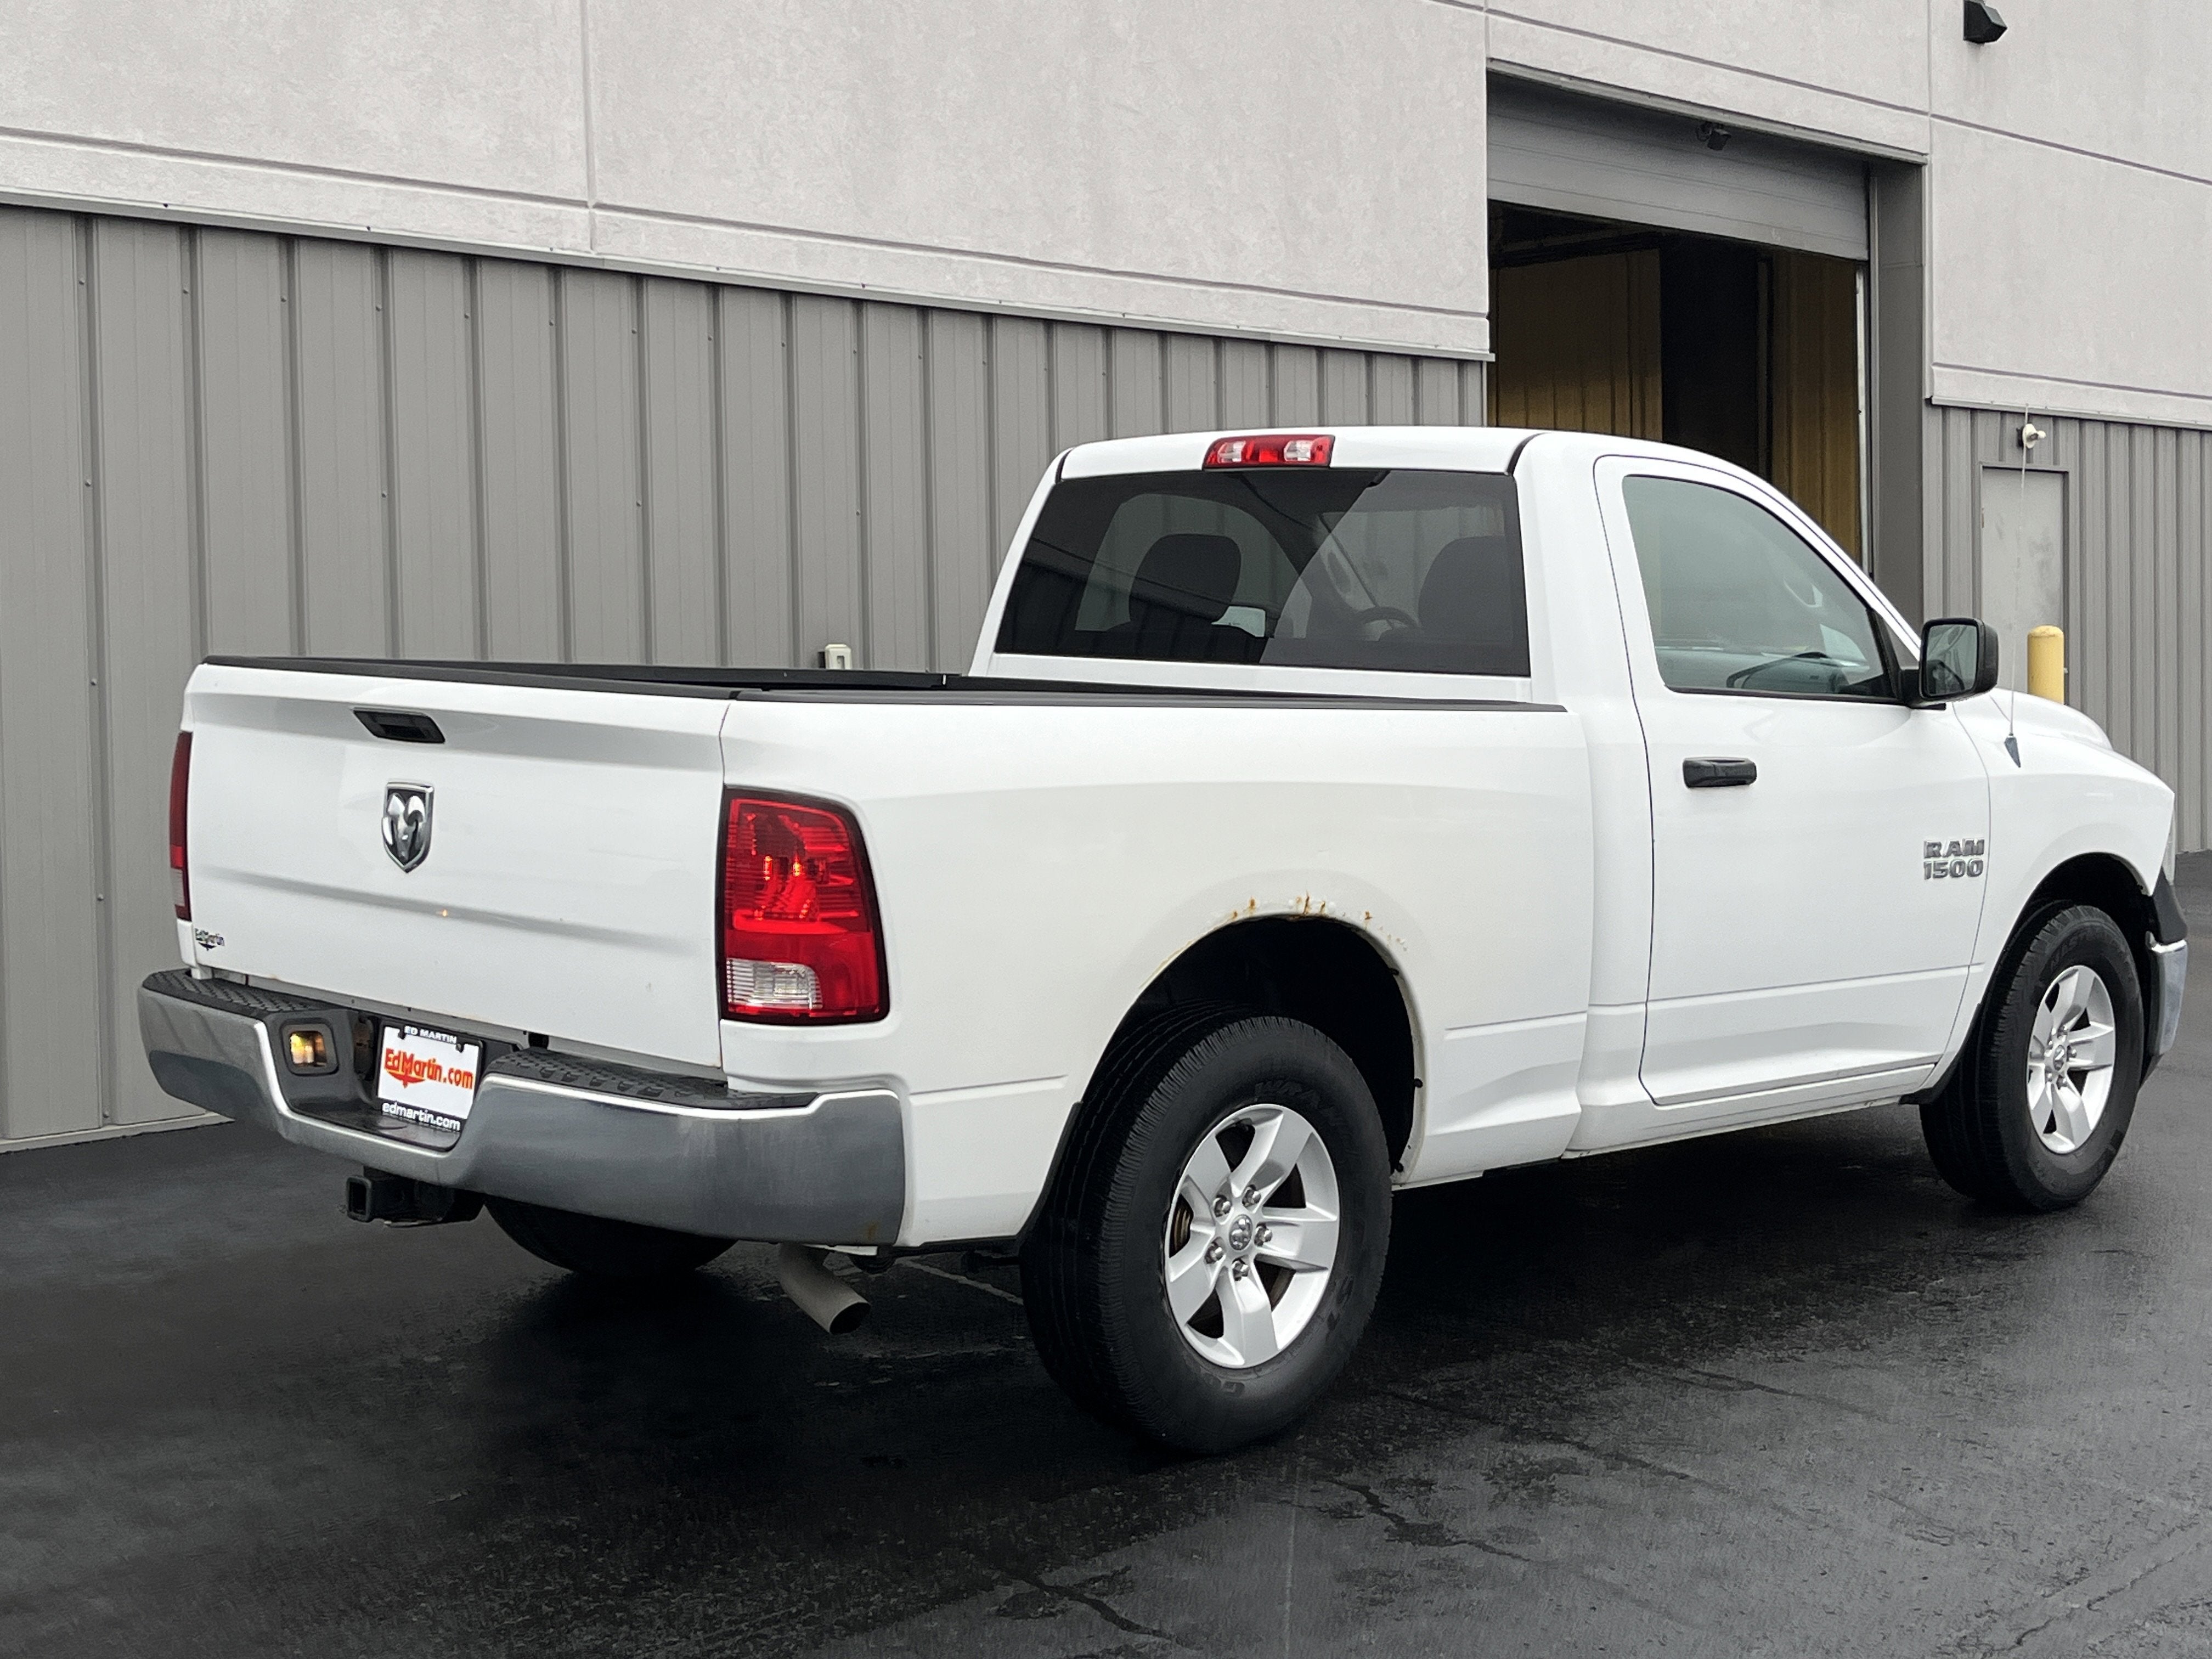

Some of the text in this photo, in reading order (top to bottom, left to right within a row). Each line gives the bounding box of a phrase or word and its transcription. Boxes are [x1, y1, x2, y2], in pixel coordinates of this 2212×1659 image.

[1923, 838, 1984, 859] RAM
[1923, 859, 1983, 880] 1500
[404, 1025, 456, 1043] ED MARTIN
[382, 1101, 460, 1130] edmartin.com
